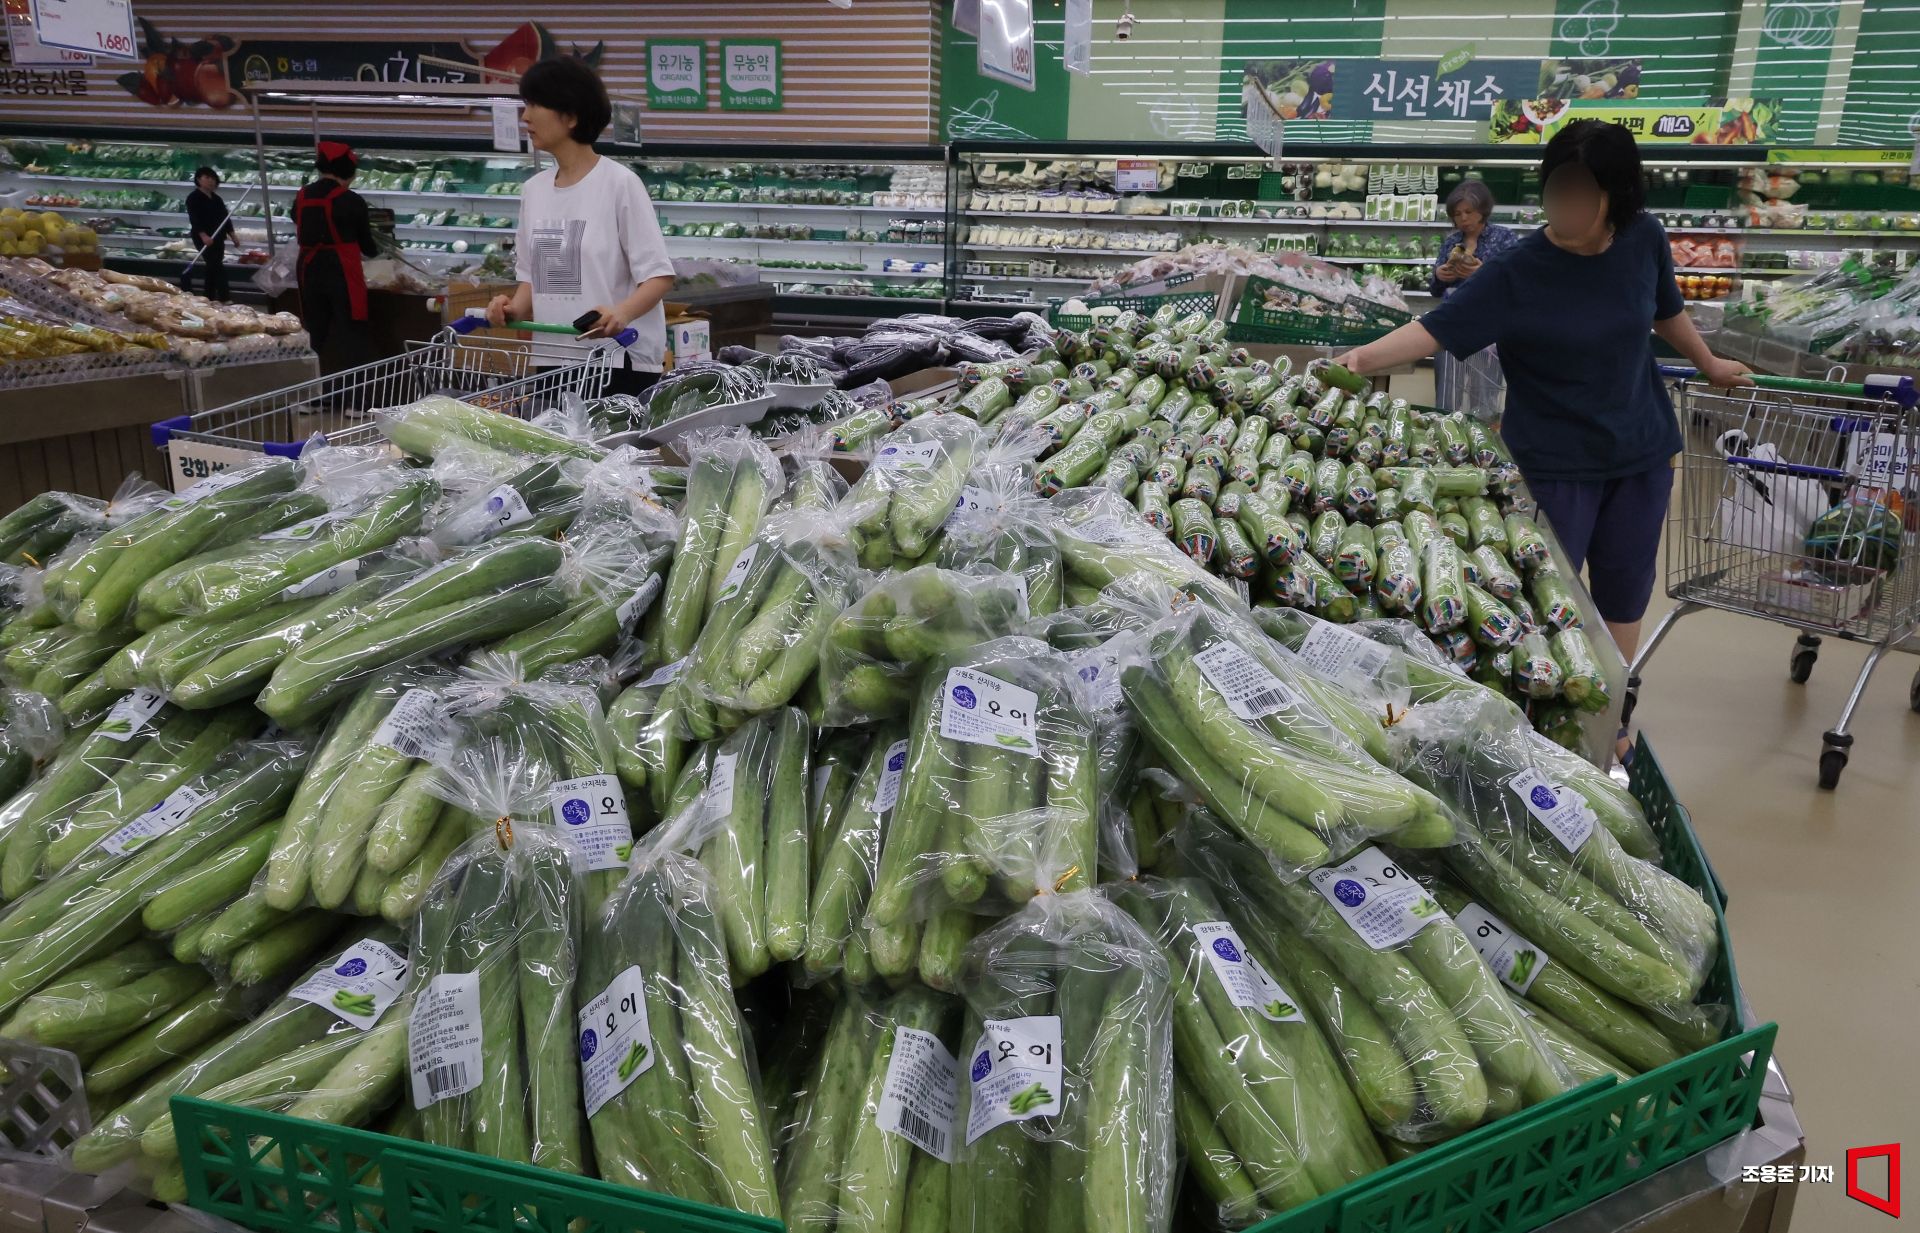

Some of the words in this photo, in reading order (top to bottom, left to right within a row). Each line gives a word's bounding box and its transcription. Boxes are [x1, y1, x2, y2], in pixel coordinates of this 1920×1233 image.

[96, 31, 131, 52] 1,680
[291, 58, 318, 72] 농협
[658, 54, 694, 72] 유기농
[733, 54, 769, 72] 무농약
[1440, 48, 1471, 72] Fresh
[660, 73, 693, 81] (ORGANIC)
[1363, 70, 1503, 117] 신선채소
[1658, 115, 1690, 133] 채소
[984, 700, 1028, 726] 오이
[581, 779, 608, 789] 산지직송
[600, 796, 626, 815] 오
[1200, 926, 1222, 934] 강원도
[605, 992, 637, 1039] 오이
[998, 1040, 1052, 1065] 오이
